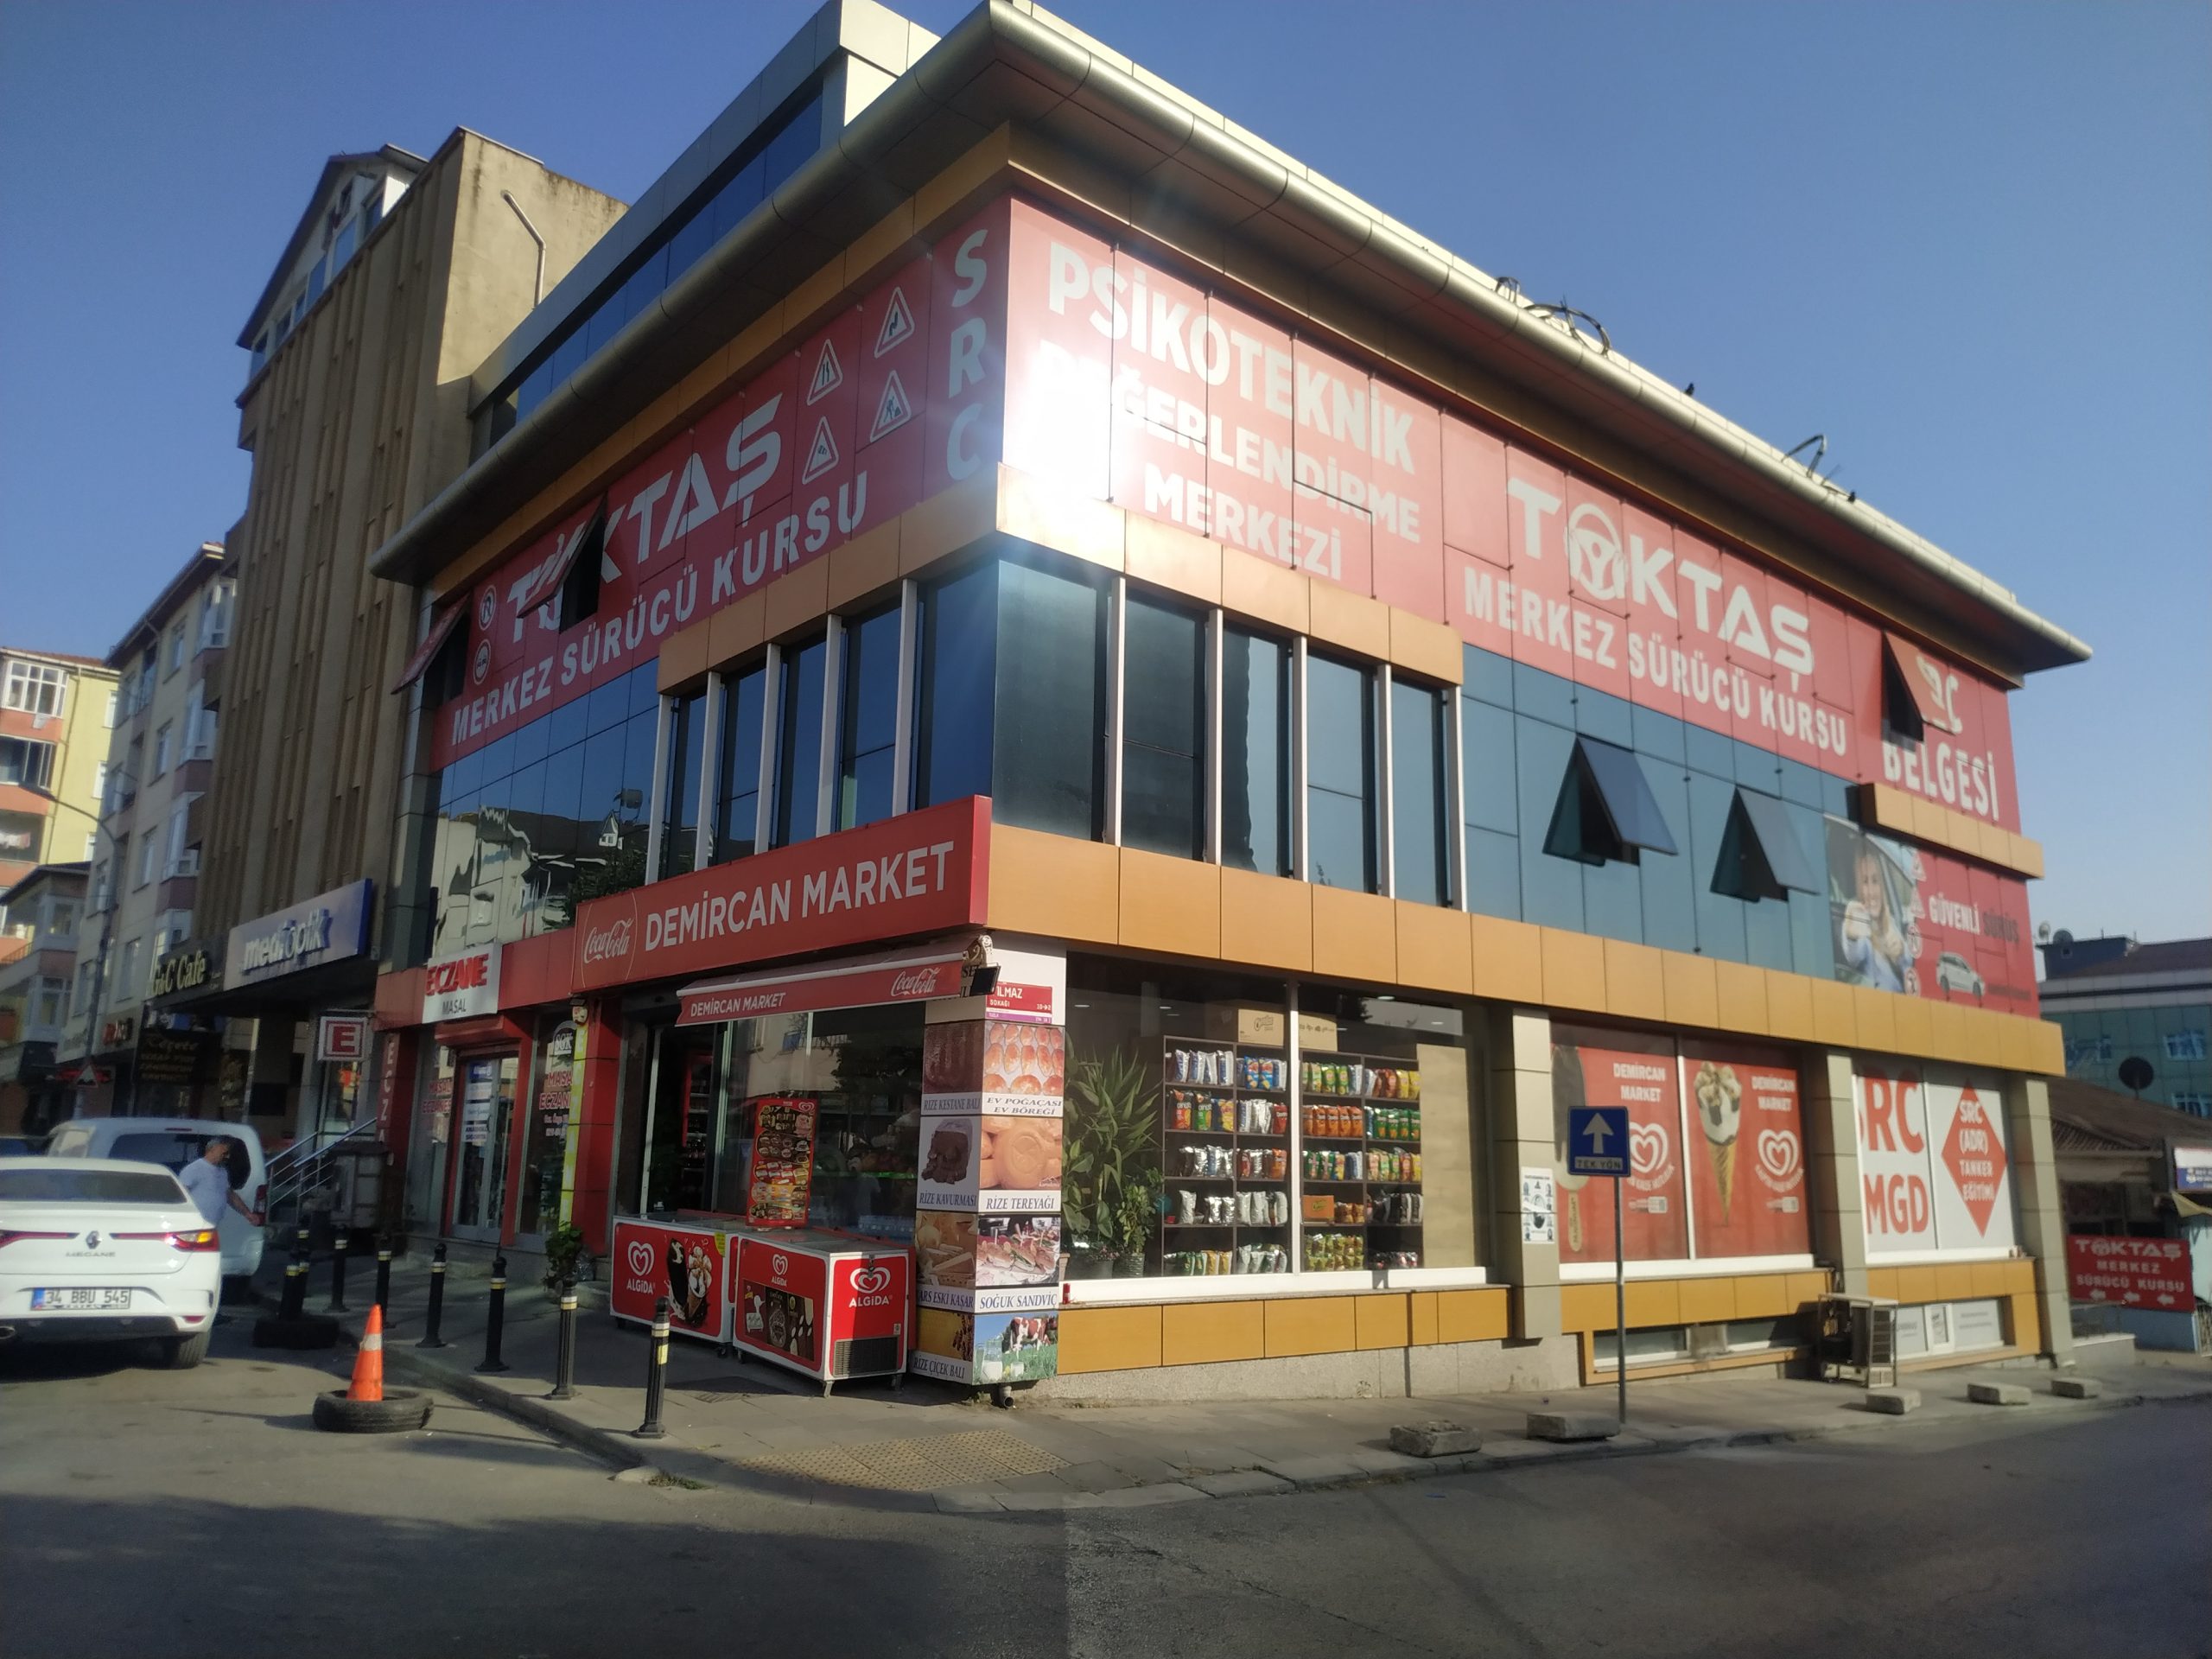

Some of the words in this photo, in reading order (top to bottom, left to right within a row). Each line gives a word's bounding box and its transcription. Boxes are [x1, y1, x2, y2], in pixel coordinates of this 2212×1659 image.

[1049, 240, 1415, 475] PSİKOTEKNİK
[1039, 340, 1421, 544] ĞERLENDİRME
[1145, 462, 1342, 582] MERKEZİ
[452, 656, 554, 747] MERKEZ
[561, 563, 699, 685] SÜRÜCÜ
[712, 471, 868, 604] KURSU
[1464, 567, 1617, 671] MERKEZ
[1628, 632, 1751, 721] SÜRÜCÜ
[1758, 690, 1847, 757] KURSU
[1882, 741, 2000, 822] BELGESİ
[645, 879, 792, 951] DEMİRCAN
[802, 841, 954, 918] MARKET
[426, 953, 489, 996] ECZANE
[992, 986, 1023, 1000] ILMAZ
[442, 998, 467, 1015] MASAL
[690, 999, 741, 1018] DEMİRCAN
[742, 992, 786, 1014] MARKET
[332, 1027, 355, 1052] E
[548, 1070, 573, 1088] MASA
[1613, 1061, 1666, 1081] DEMİRCAN
[539, 1091, 571, 1110] ECZAN
[1005, 1097, 1062, 1108] POĞAÇASI
[1620, 1085, 1661, 1103] MARKET
[938, 1098, 966, 1110] KESTANE
[1859, 1070, 1924, 1154] RC
[1959, 1100, 1983, 1124] SRC
[919, 1190, 936, 1205] RİZE
[936, 1193, 977, 1208] KAVURMASI
[986, 1196, 1008, 1210] RİZE
[1011, 1195, 1054, 1210] TEREYAĞI
[2096, 1260, 2160, 1274] MERKEZ
[2137, 1278, 2185, 1293] KURSU
[46, 1289, 62, 1304] 34
[105, 1289, 128, 1304] 545
[919, 1290, 932, 1302] ARS
[932, 1291, 950, 1305] ESKİ
[980, 1294, 1015, 1310] SOĞUK
[1016, 1291, 1058, 1308] SANDVİÇ
[913, 1355, 928, 1372] RİZE
